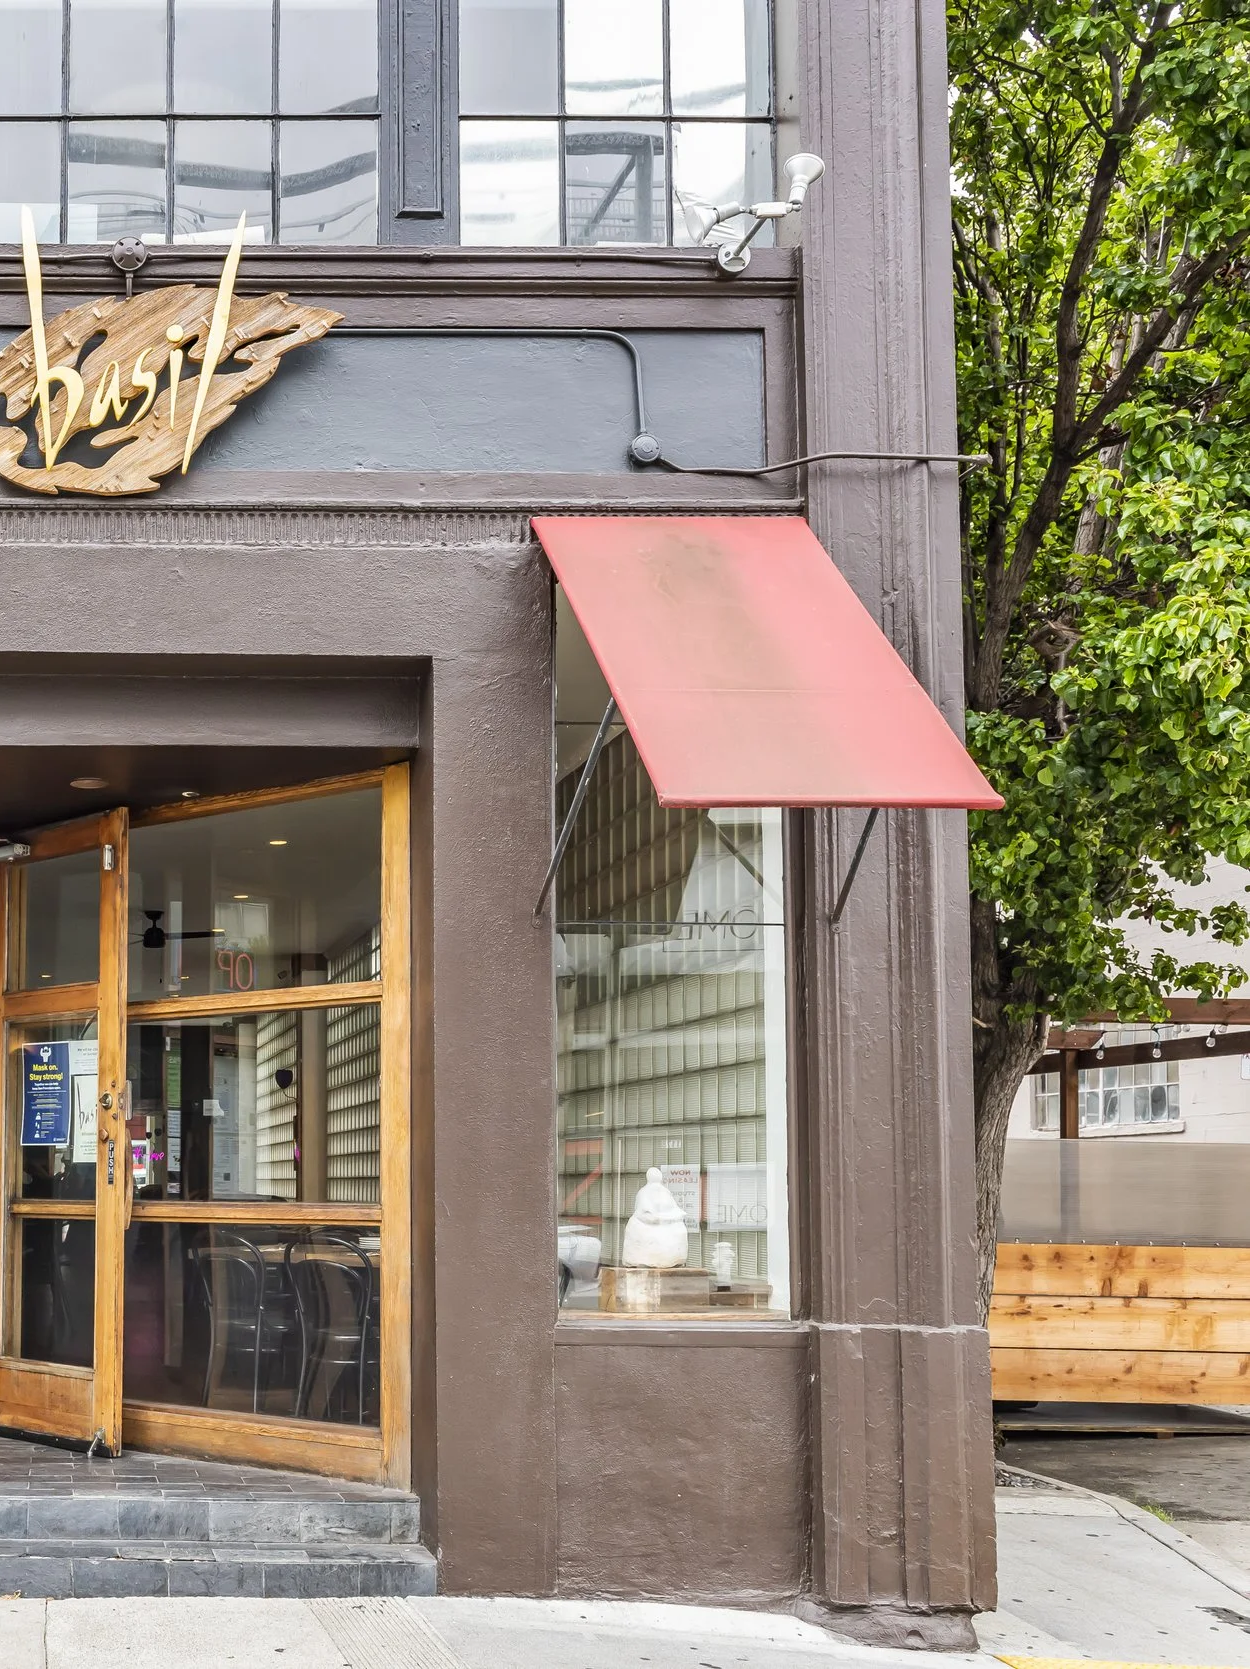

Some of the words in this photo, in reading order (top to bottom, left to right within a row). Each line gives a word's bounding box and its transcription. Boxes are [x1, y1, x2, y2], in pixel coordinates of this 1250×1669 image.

[21, 205, 246, 475] basil
[30, 1073, 42, 1081] Stay
[43, 1072, 63, 1081] strong!
